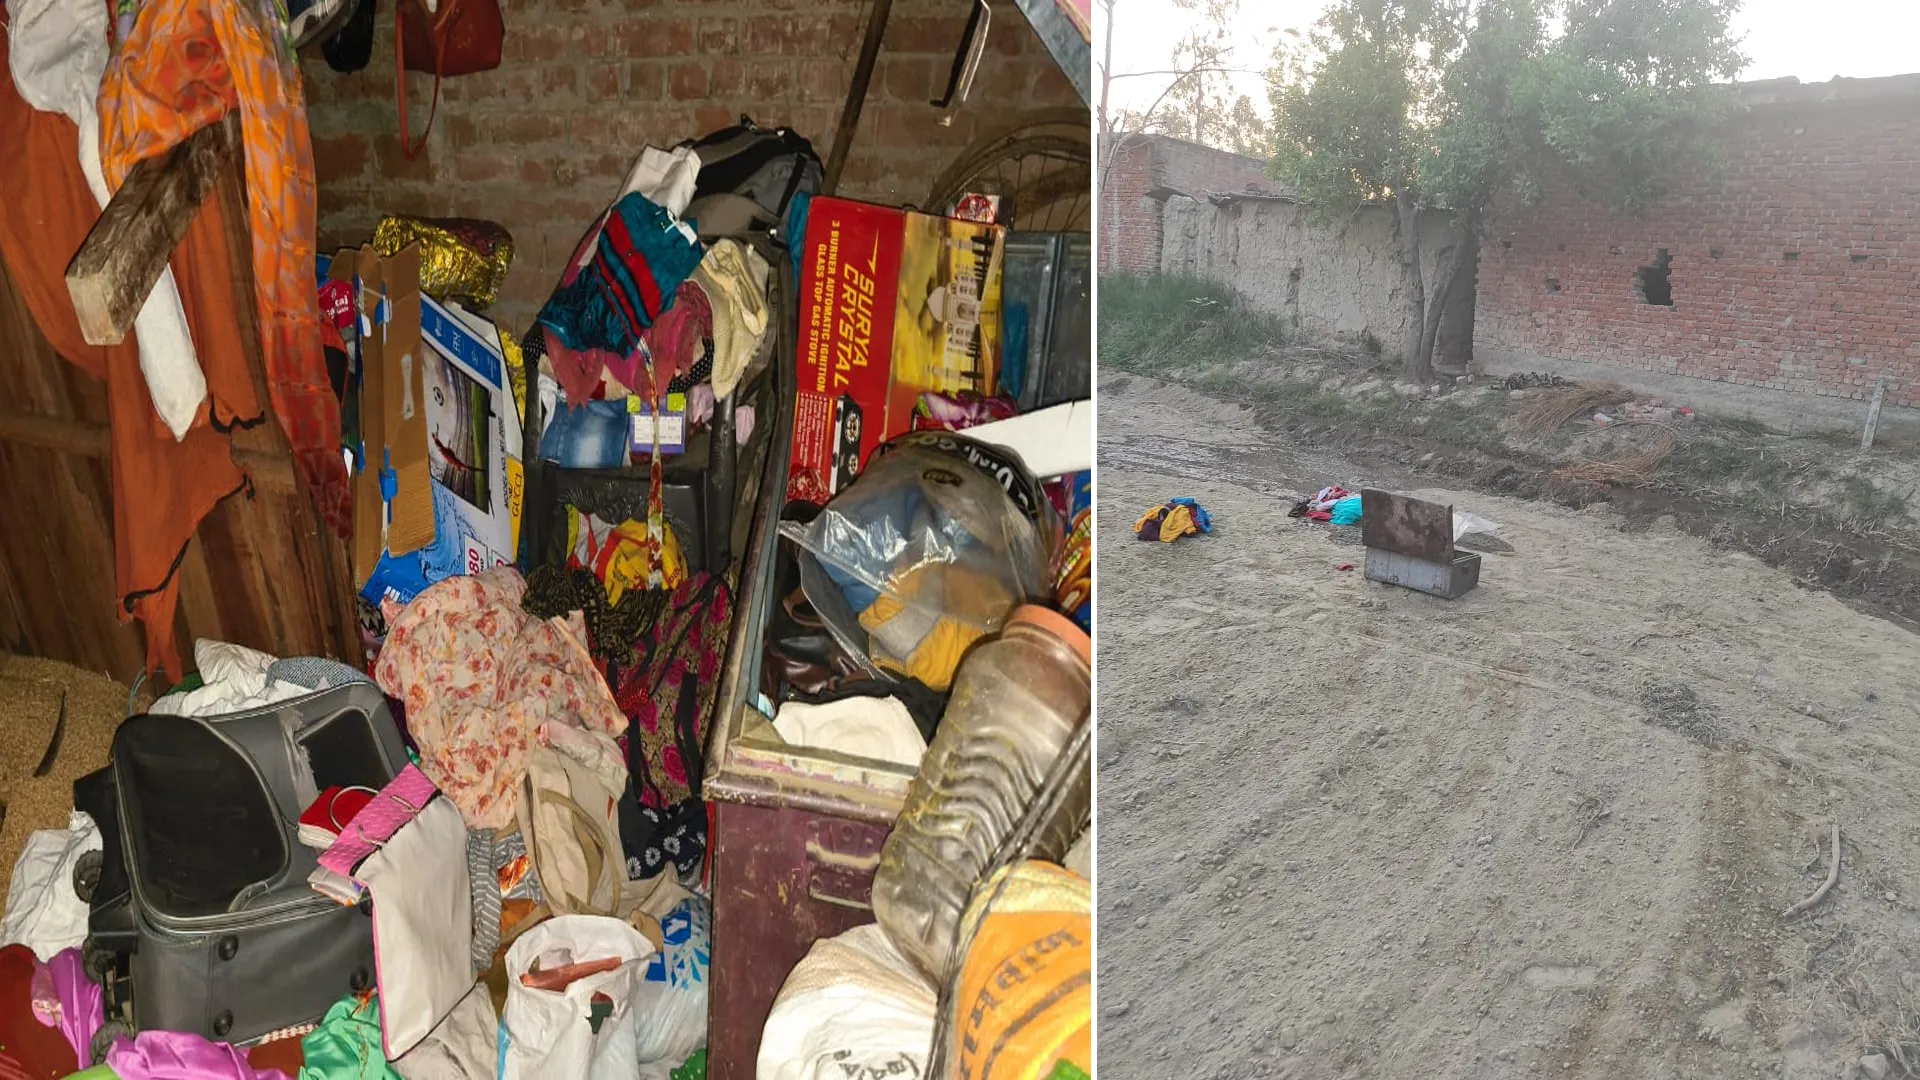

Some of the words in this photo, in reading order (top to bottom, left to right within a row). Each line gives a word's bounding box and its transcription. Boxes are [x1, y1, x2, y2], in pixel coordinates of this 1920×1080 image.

[816, 243, 827, 278] GLASS
[828, 230, 840, 274] BURNER
[814, 280, 825, 302] TOP
[821, 278, 836, 340] AUTOMATIC
[811, 305, 821, 327] GAS
[833, 263, 859, 388] CRYSTAL
[853, 273, 875, 367] SURYA
[808, 328, 819, 365] STOVE
[816, 344, 829, 393] IGNITION
[512, 473, 523, 517] GUCCI
[469, 548, 480, 576] 80
